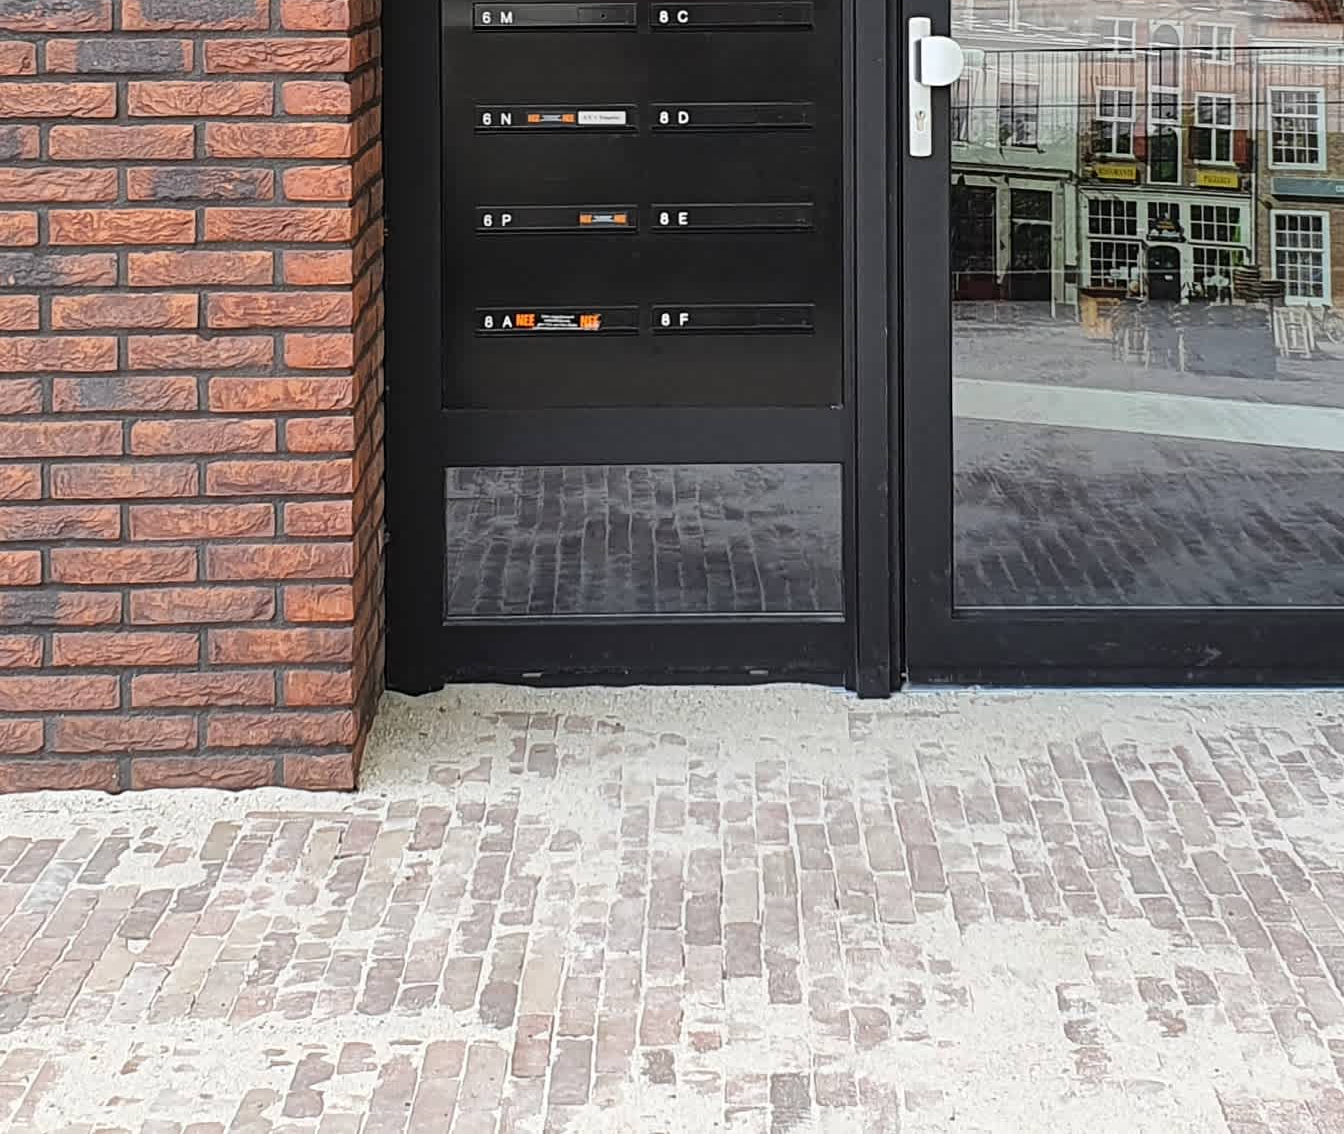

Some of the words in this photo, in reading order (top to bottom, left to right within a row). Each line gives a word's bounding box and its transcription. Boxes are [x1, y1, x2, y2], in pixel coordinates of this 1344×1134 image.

[482, 11, 492, 24] 6
[500, 10, 513, 24] M
[659, 10, 669, 24] 8
[677, 9, 689, 23] C
[482, 112, 492, 126] 6
[500, 112, 512, 125] N
[659, 111, 669, 125] 8
[678, 110, 689, 124] D
[483, 214, 493, 227] 6
[501, 213, 512, 227] P
[659, 212, 670, 226] 8
[678, 211, 689, 226] E
[484, 315, 494, 329] 8
[502, 315, 513, 328] A
[515, 313, 535, 327] NEE
[661, 313, 671, 327] 8
[679, 312, 689, 326] F
